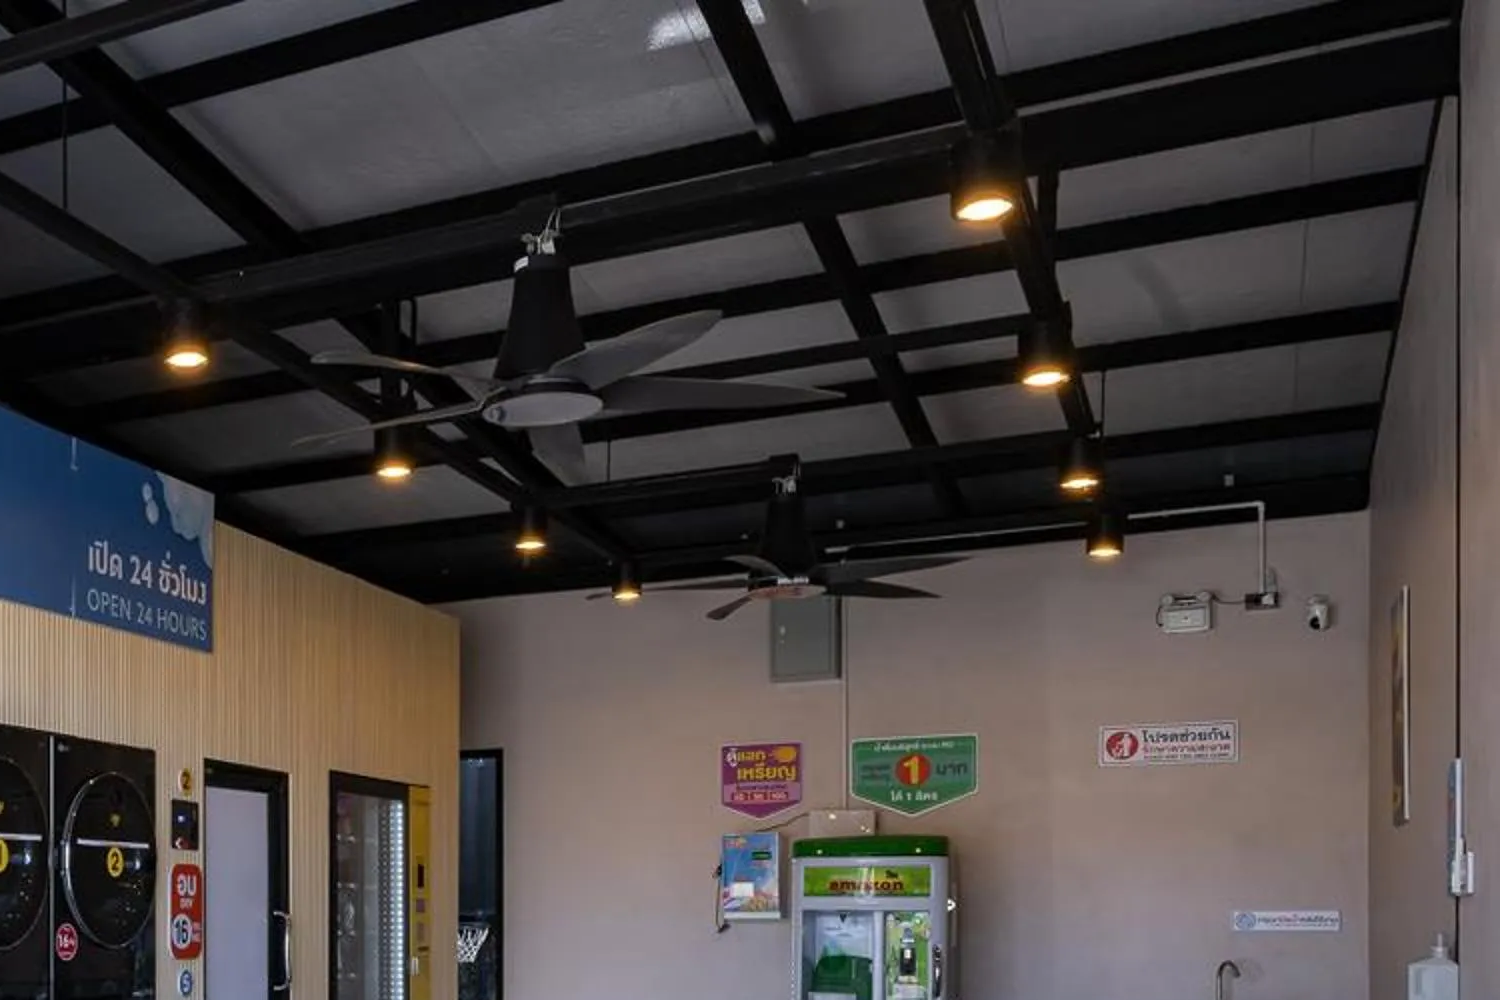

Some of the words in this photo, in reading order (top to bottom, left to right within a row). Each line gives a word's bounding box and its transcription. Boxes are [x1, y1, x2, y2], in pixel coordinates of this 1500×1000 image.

[88, 540, 123, 580] เปิด
[130, 555, 152, 588] 24
[159, 551, 207, 605] ชั่วโมง
[87, 588, 131, 621] OPEN
[136, 602, 152, 625] 24
[157, 608, 207, 641] HOURS
[1142, 728, 1231, 742] โปรดช่วยกัน
[182, 770, 189, 786] 2
[903, 755, 919, 784] 1
[936, 762, 967, 776] บาท
[111, 850, 119, 868] 2
[177, 873, 196, 897] อบ
[175, 920, 188, 944] 16
